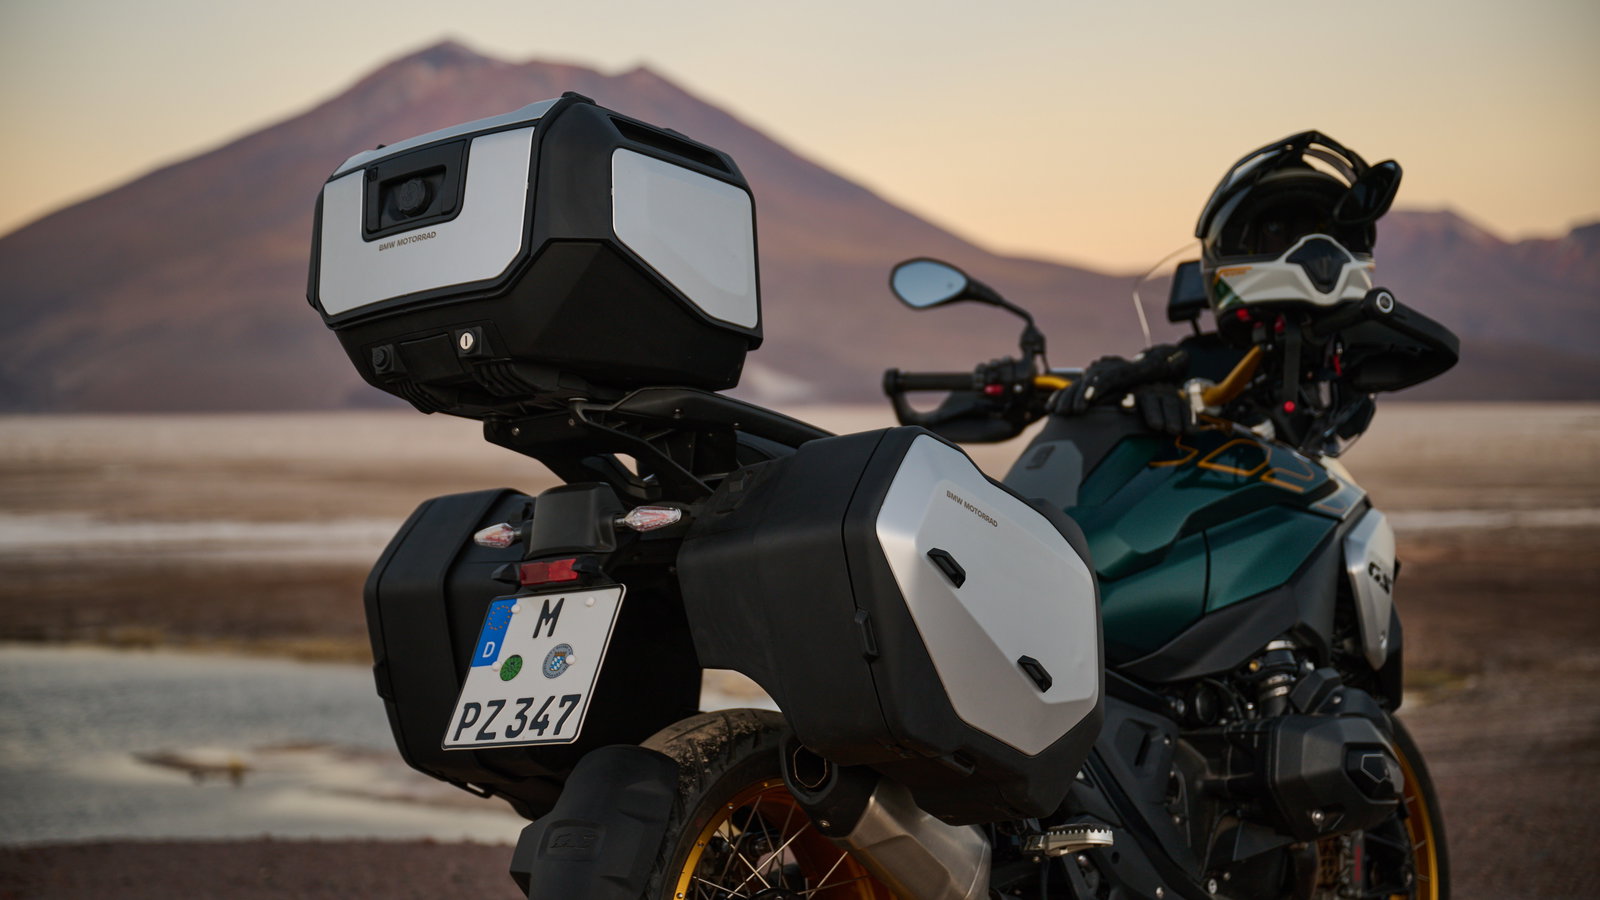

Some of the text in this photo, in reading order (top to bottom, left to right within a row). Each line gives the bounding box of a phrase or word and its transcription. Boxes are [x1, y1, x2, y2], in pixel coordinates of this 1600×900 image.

[379, 231, 437, 251] BMW MOTORRAD
[946, 490, 998, 527] BMW MOTORRAD
[532, 598, 565, 639] M
[482, 641, 496, 658] D
